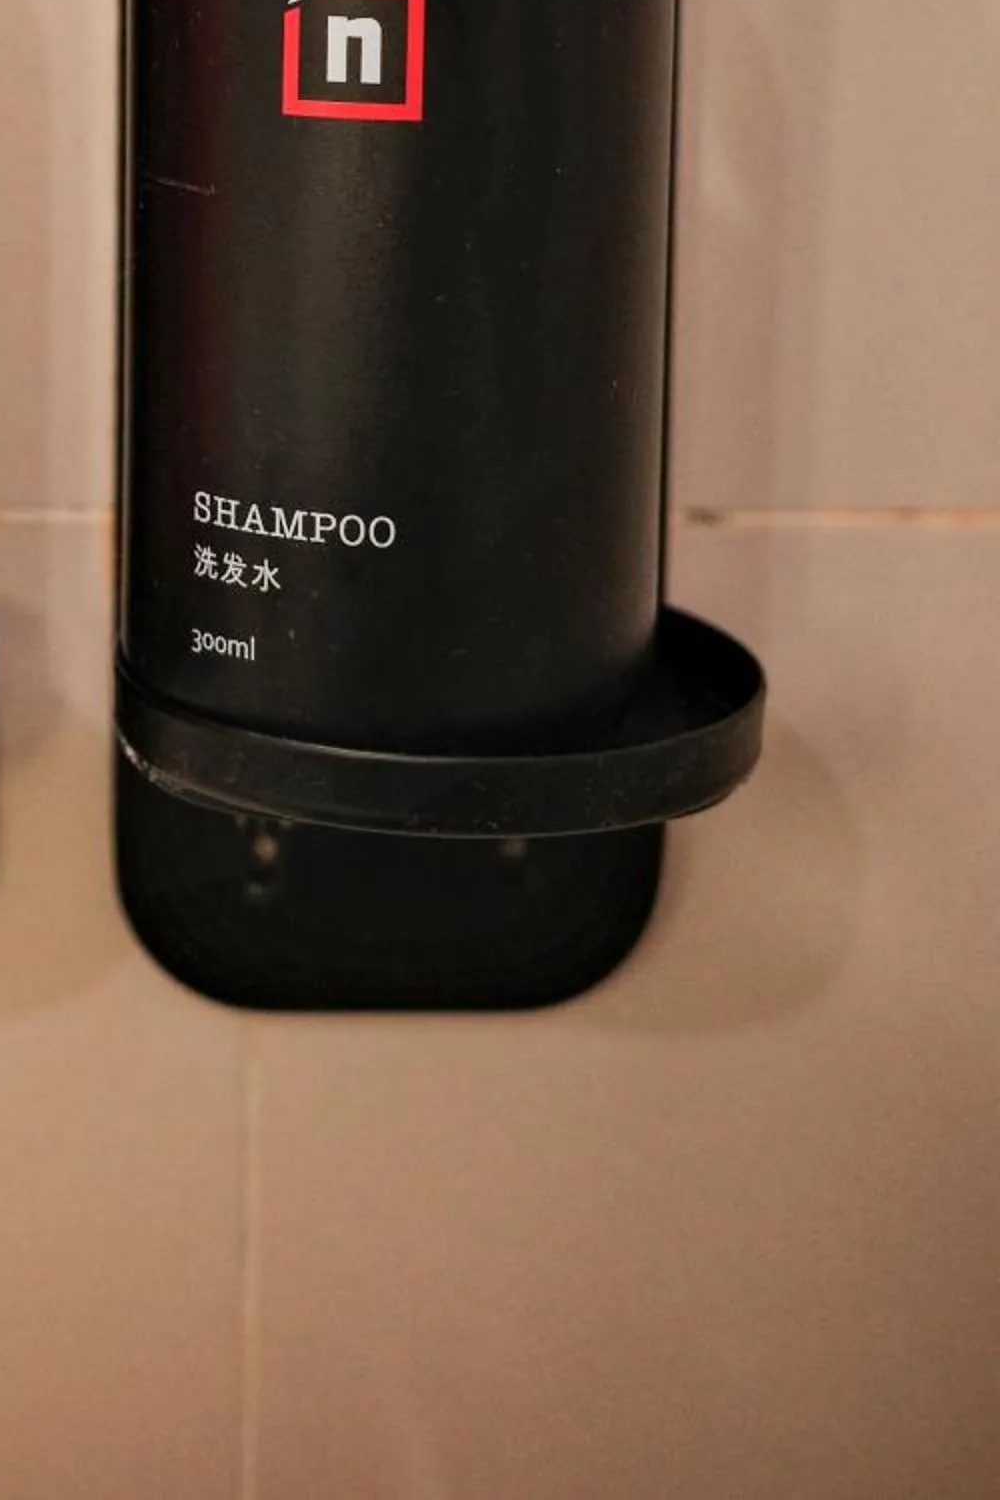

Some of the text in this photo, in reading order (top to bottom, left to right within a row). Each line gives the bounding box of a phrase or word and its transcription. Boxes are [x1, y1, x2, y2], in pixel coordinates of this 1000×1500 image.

[193, 491, 397, 549] SHAMPOO
[193, 543, 282, 592] 洗发水
[190, 627, 256, 661] 300ml
